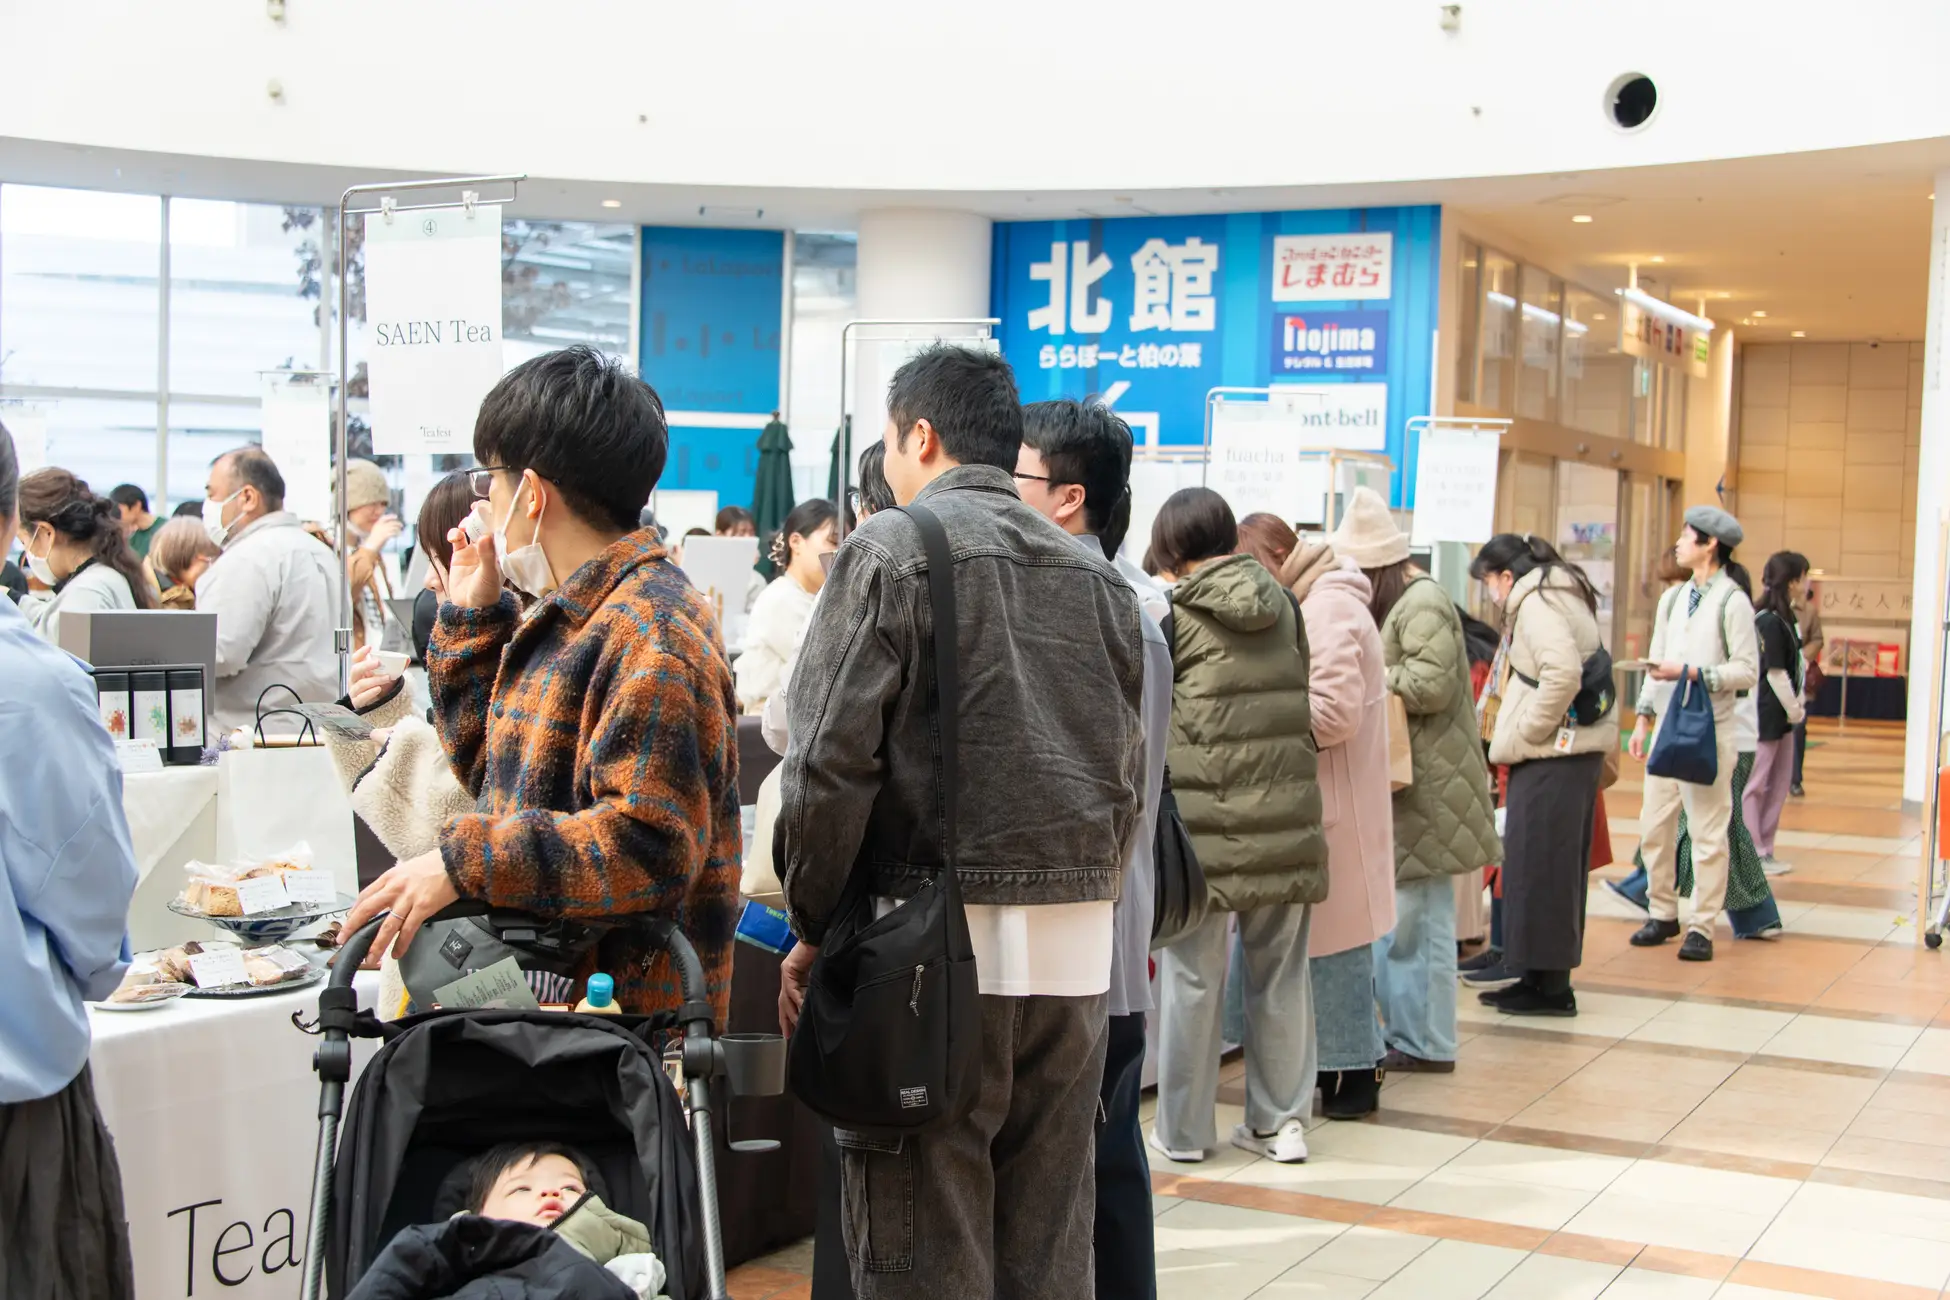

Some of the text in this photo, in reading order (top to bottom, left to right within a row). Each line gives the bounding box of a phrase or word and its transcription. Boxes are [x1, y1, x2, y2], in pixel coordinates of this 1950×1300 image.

[1027, 236, 1219, 335] 北館
[1282, 262, 1382, 289] しまむら
[376, 319, 492, 346] SAEN Tea
[1283, 316, 1376, 355] nojima
[167, 1198, 303, 1298] Tea
